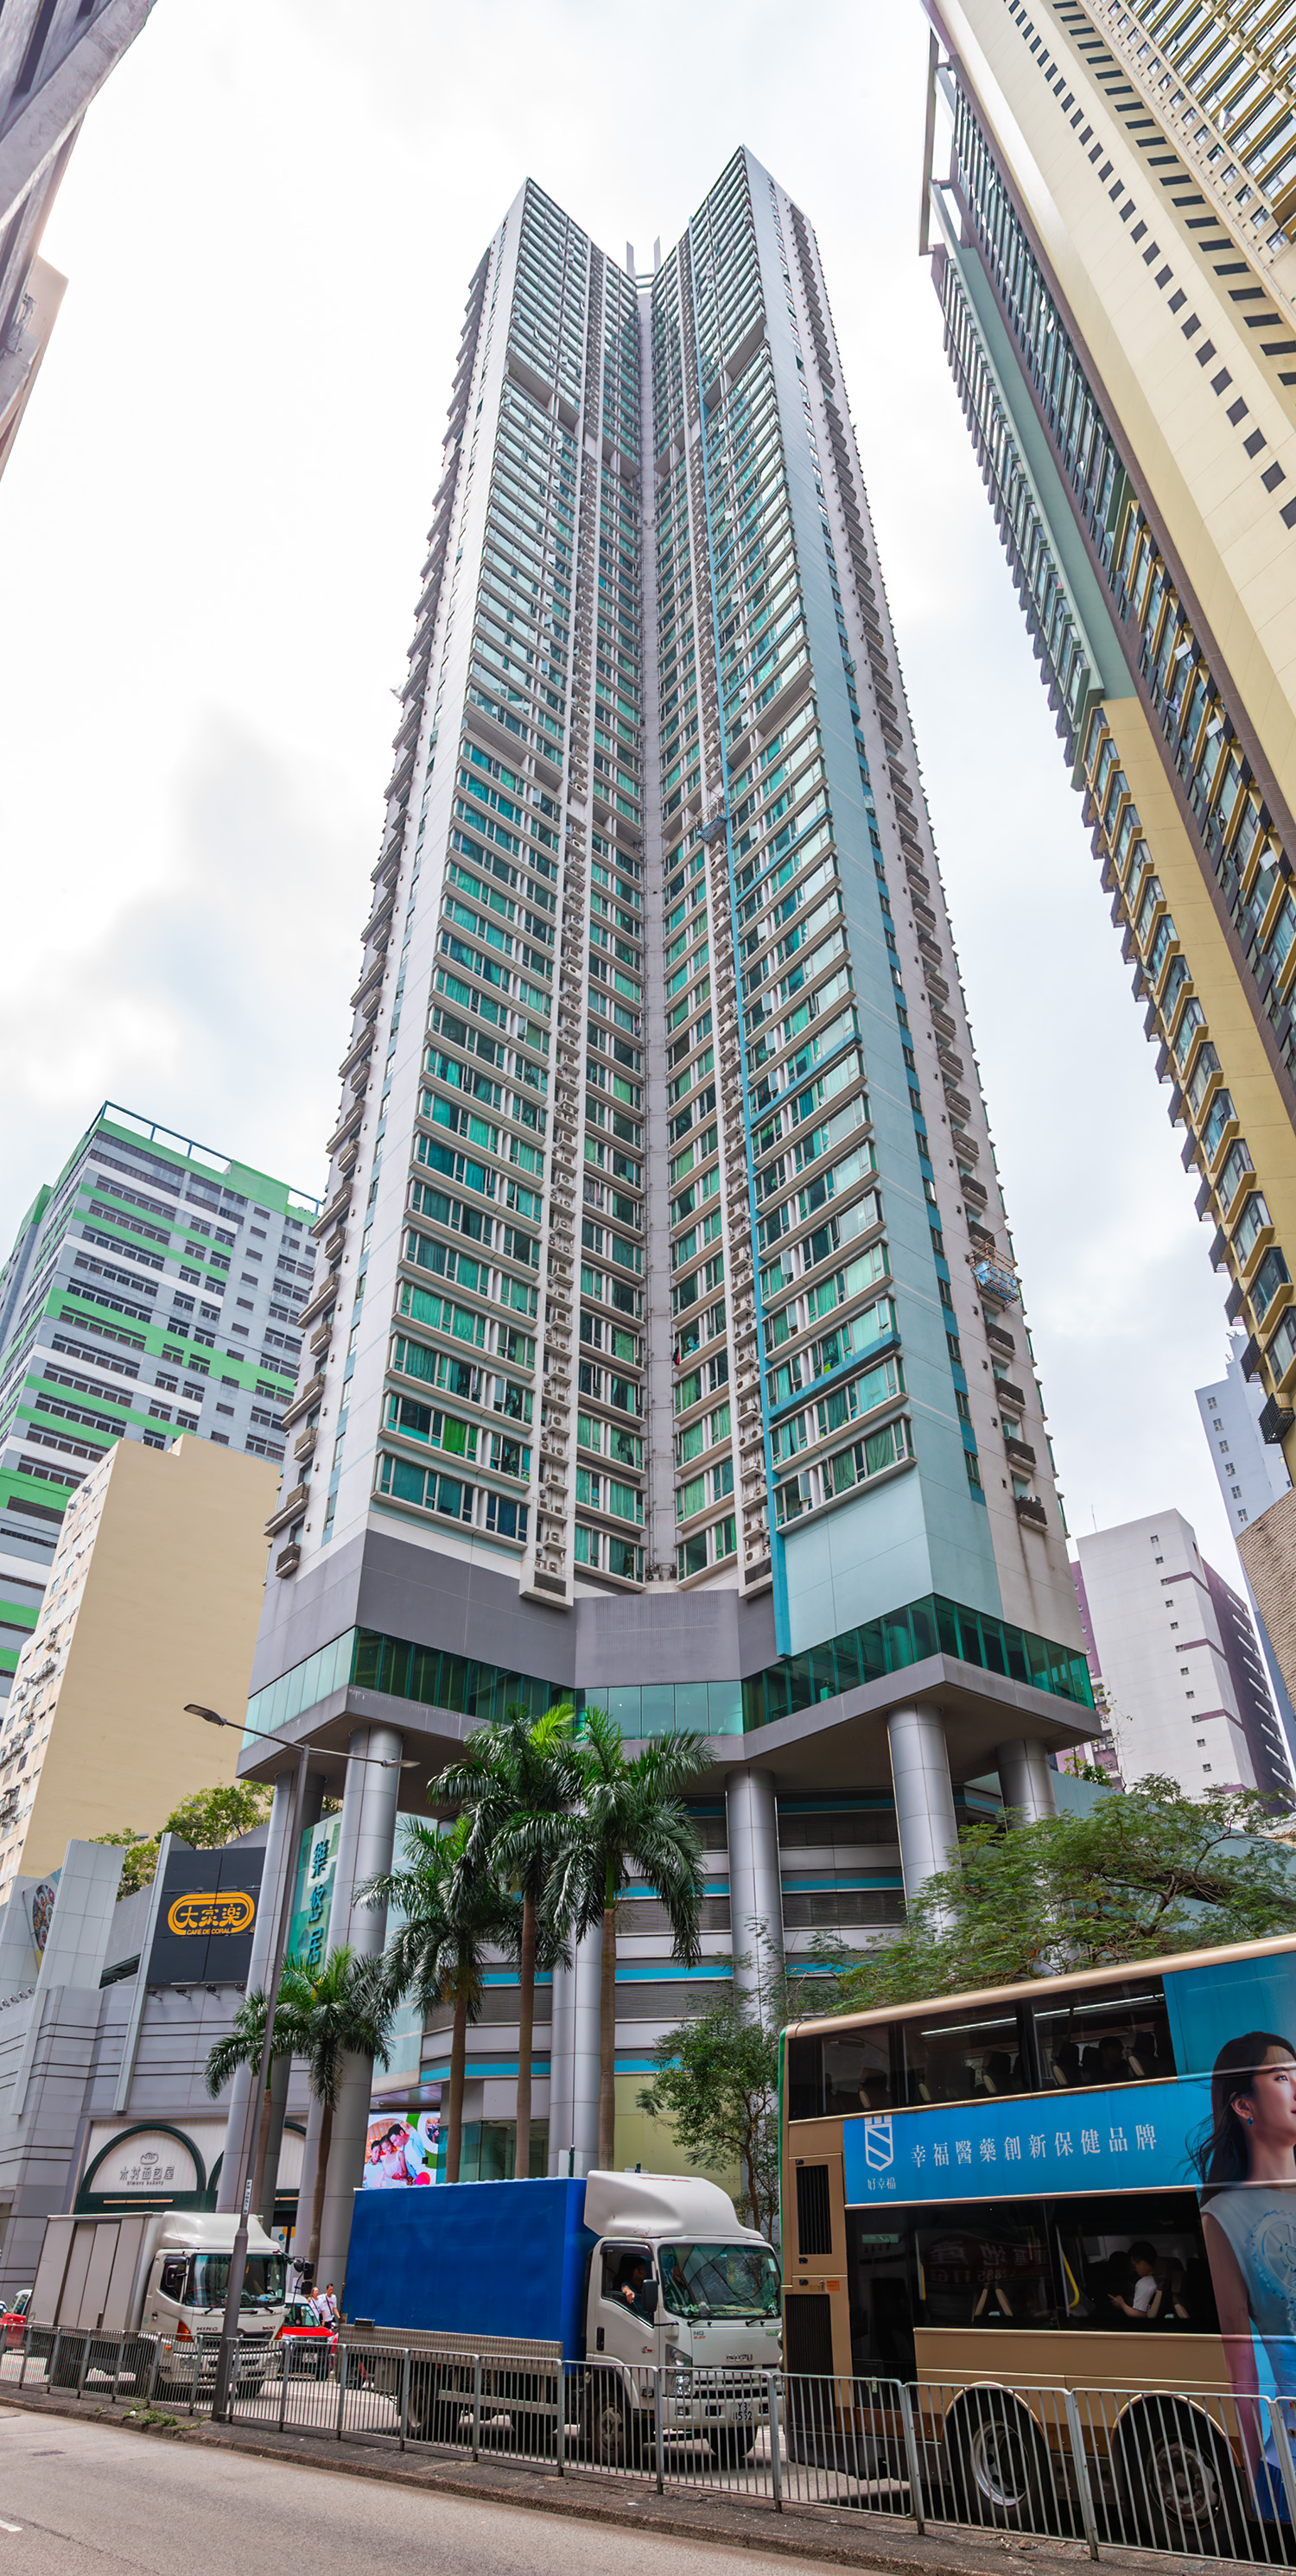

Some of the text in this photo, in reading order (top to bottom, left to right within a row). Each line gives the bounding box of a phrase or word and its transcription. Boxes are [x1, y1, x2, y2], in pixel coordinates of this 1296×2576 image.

[308, 1838, 330, 1965] 樂悠居
[911, 2124, 1157, 2167] 幸福醫藥創新保健品牌
[867, 2177, 896, 2191] 好幸福
